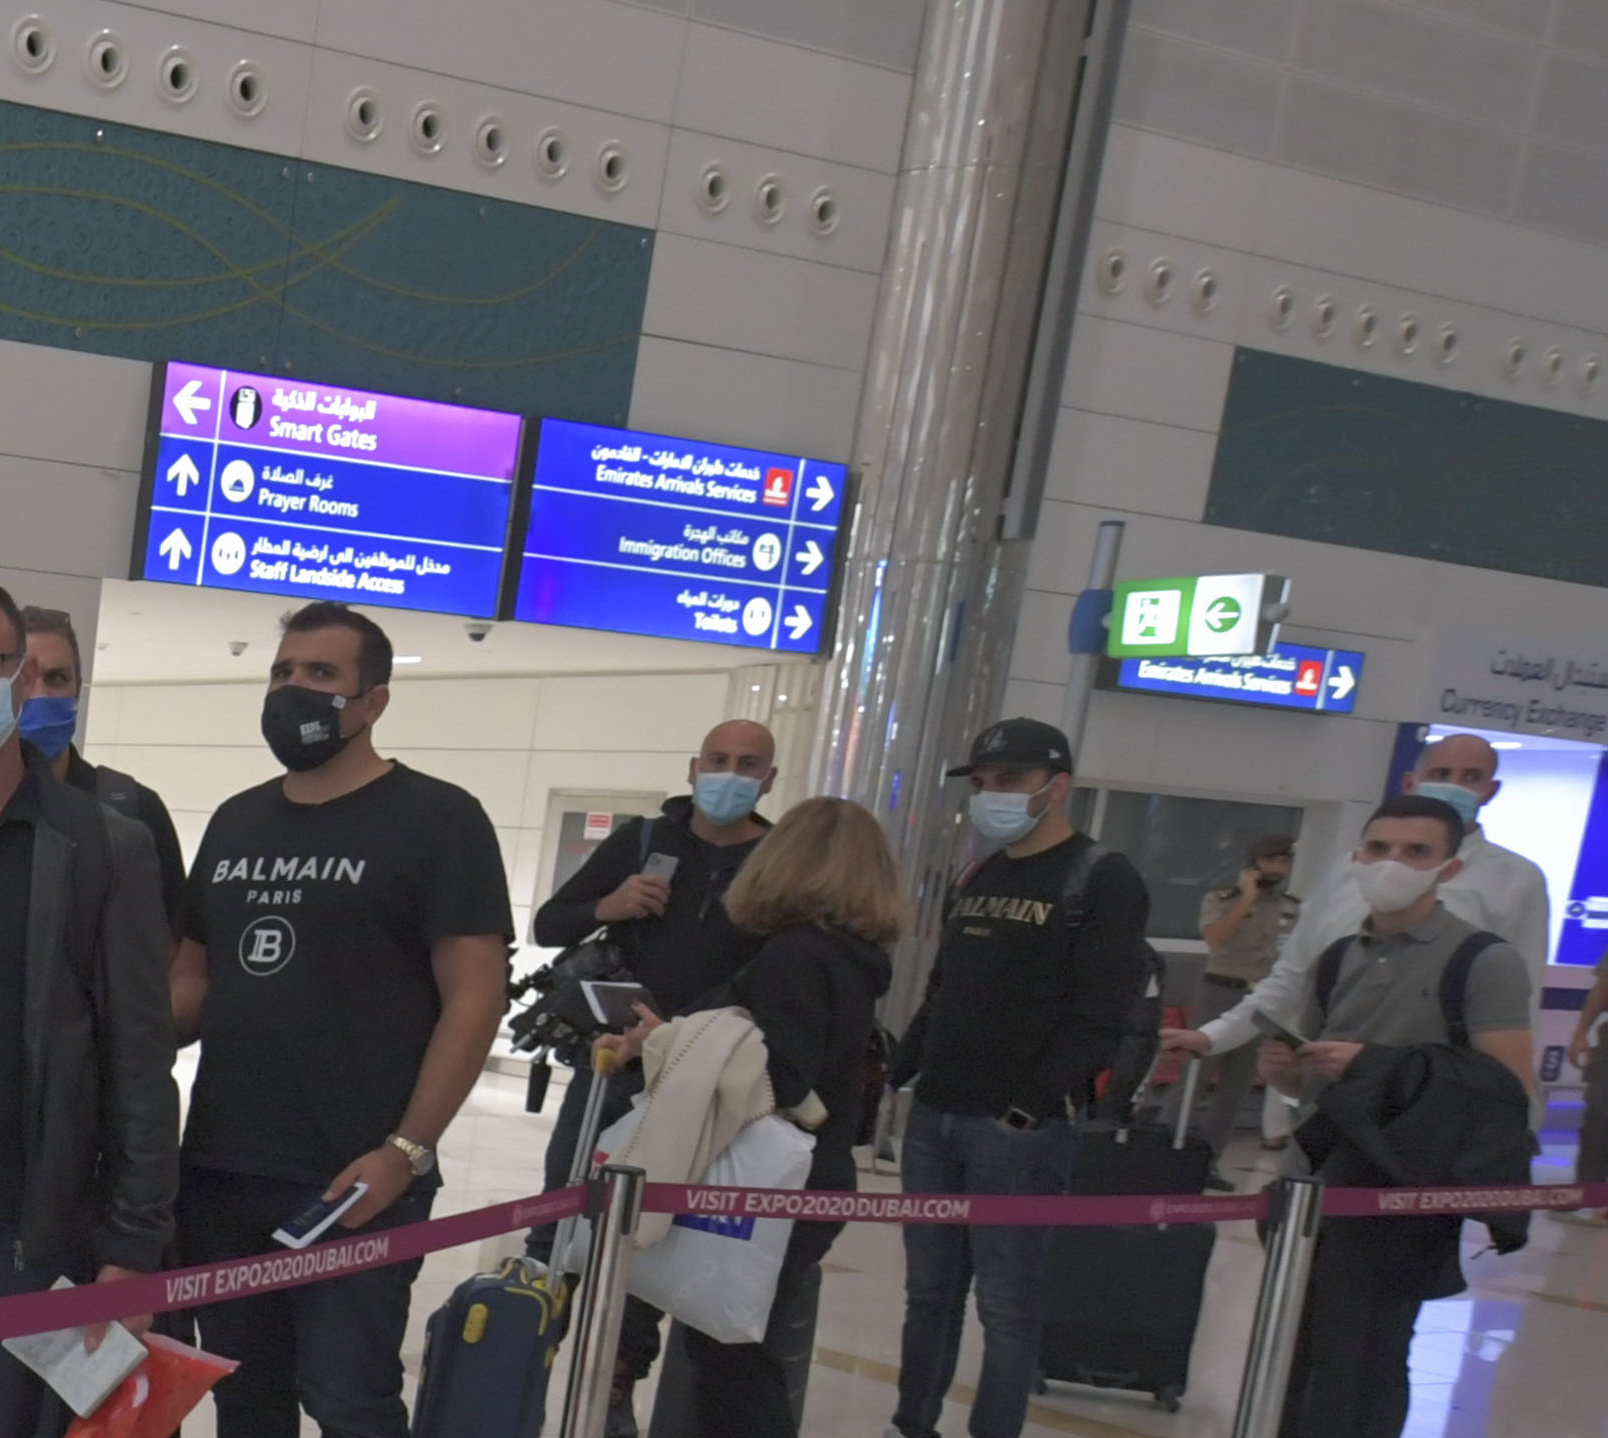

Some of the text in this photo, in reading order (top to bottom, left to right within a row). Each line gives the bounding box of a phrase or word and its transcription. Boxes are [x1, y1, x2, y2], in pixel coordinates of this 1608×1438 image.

[269, 416, 377, 451] Smart Gates
[262, 466, 333, 491] غرف الصلاة
[595, 464, 654, 489] Emirates
[655, 474, 704, 496] Arrivals
[705, 480, 757, 504] Services
[258, 488, 358, 517] Prayer Rooms
[618, 536, 746, 569] Immigration Offices
[250, 559, 405, 594] Staff Landside Access
[694, 612, 737, 634] Toilets
[1441, 689, 1608, 737] Currency Exchange
[212, 856, 366, 885] BALMAIN
[246, 889, 302, 905] PARIS
[948, 895, 1054, 926] ALMAIN
[686, 1189, 971, 1218] VISIT EXPO2020DUBAI.COM
[1378, 1191, 1418, 1210] VISIT
[166, 1237, 389, 1304] VISIT EXPO2020DUBAI.COM
